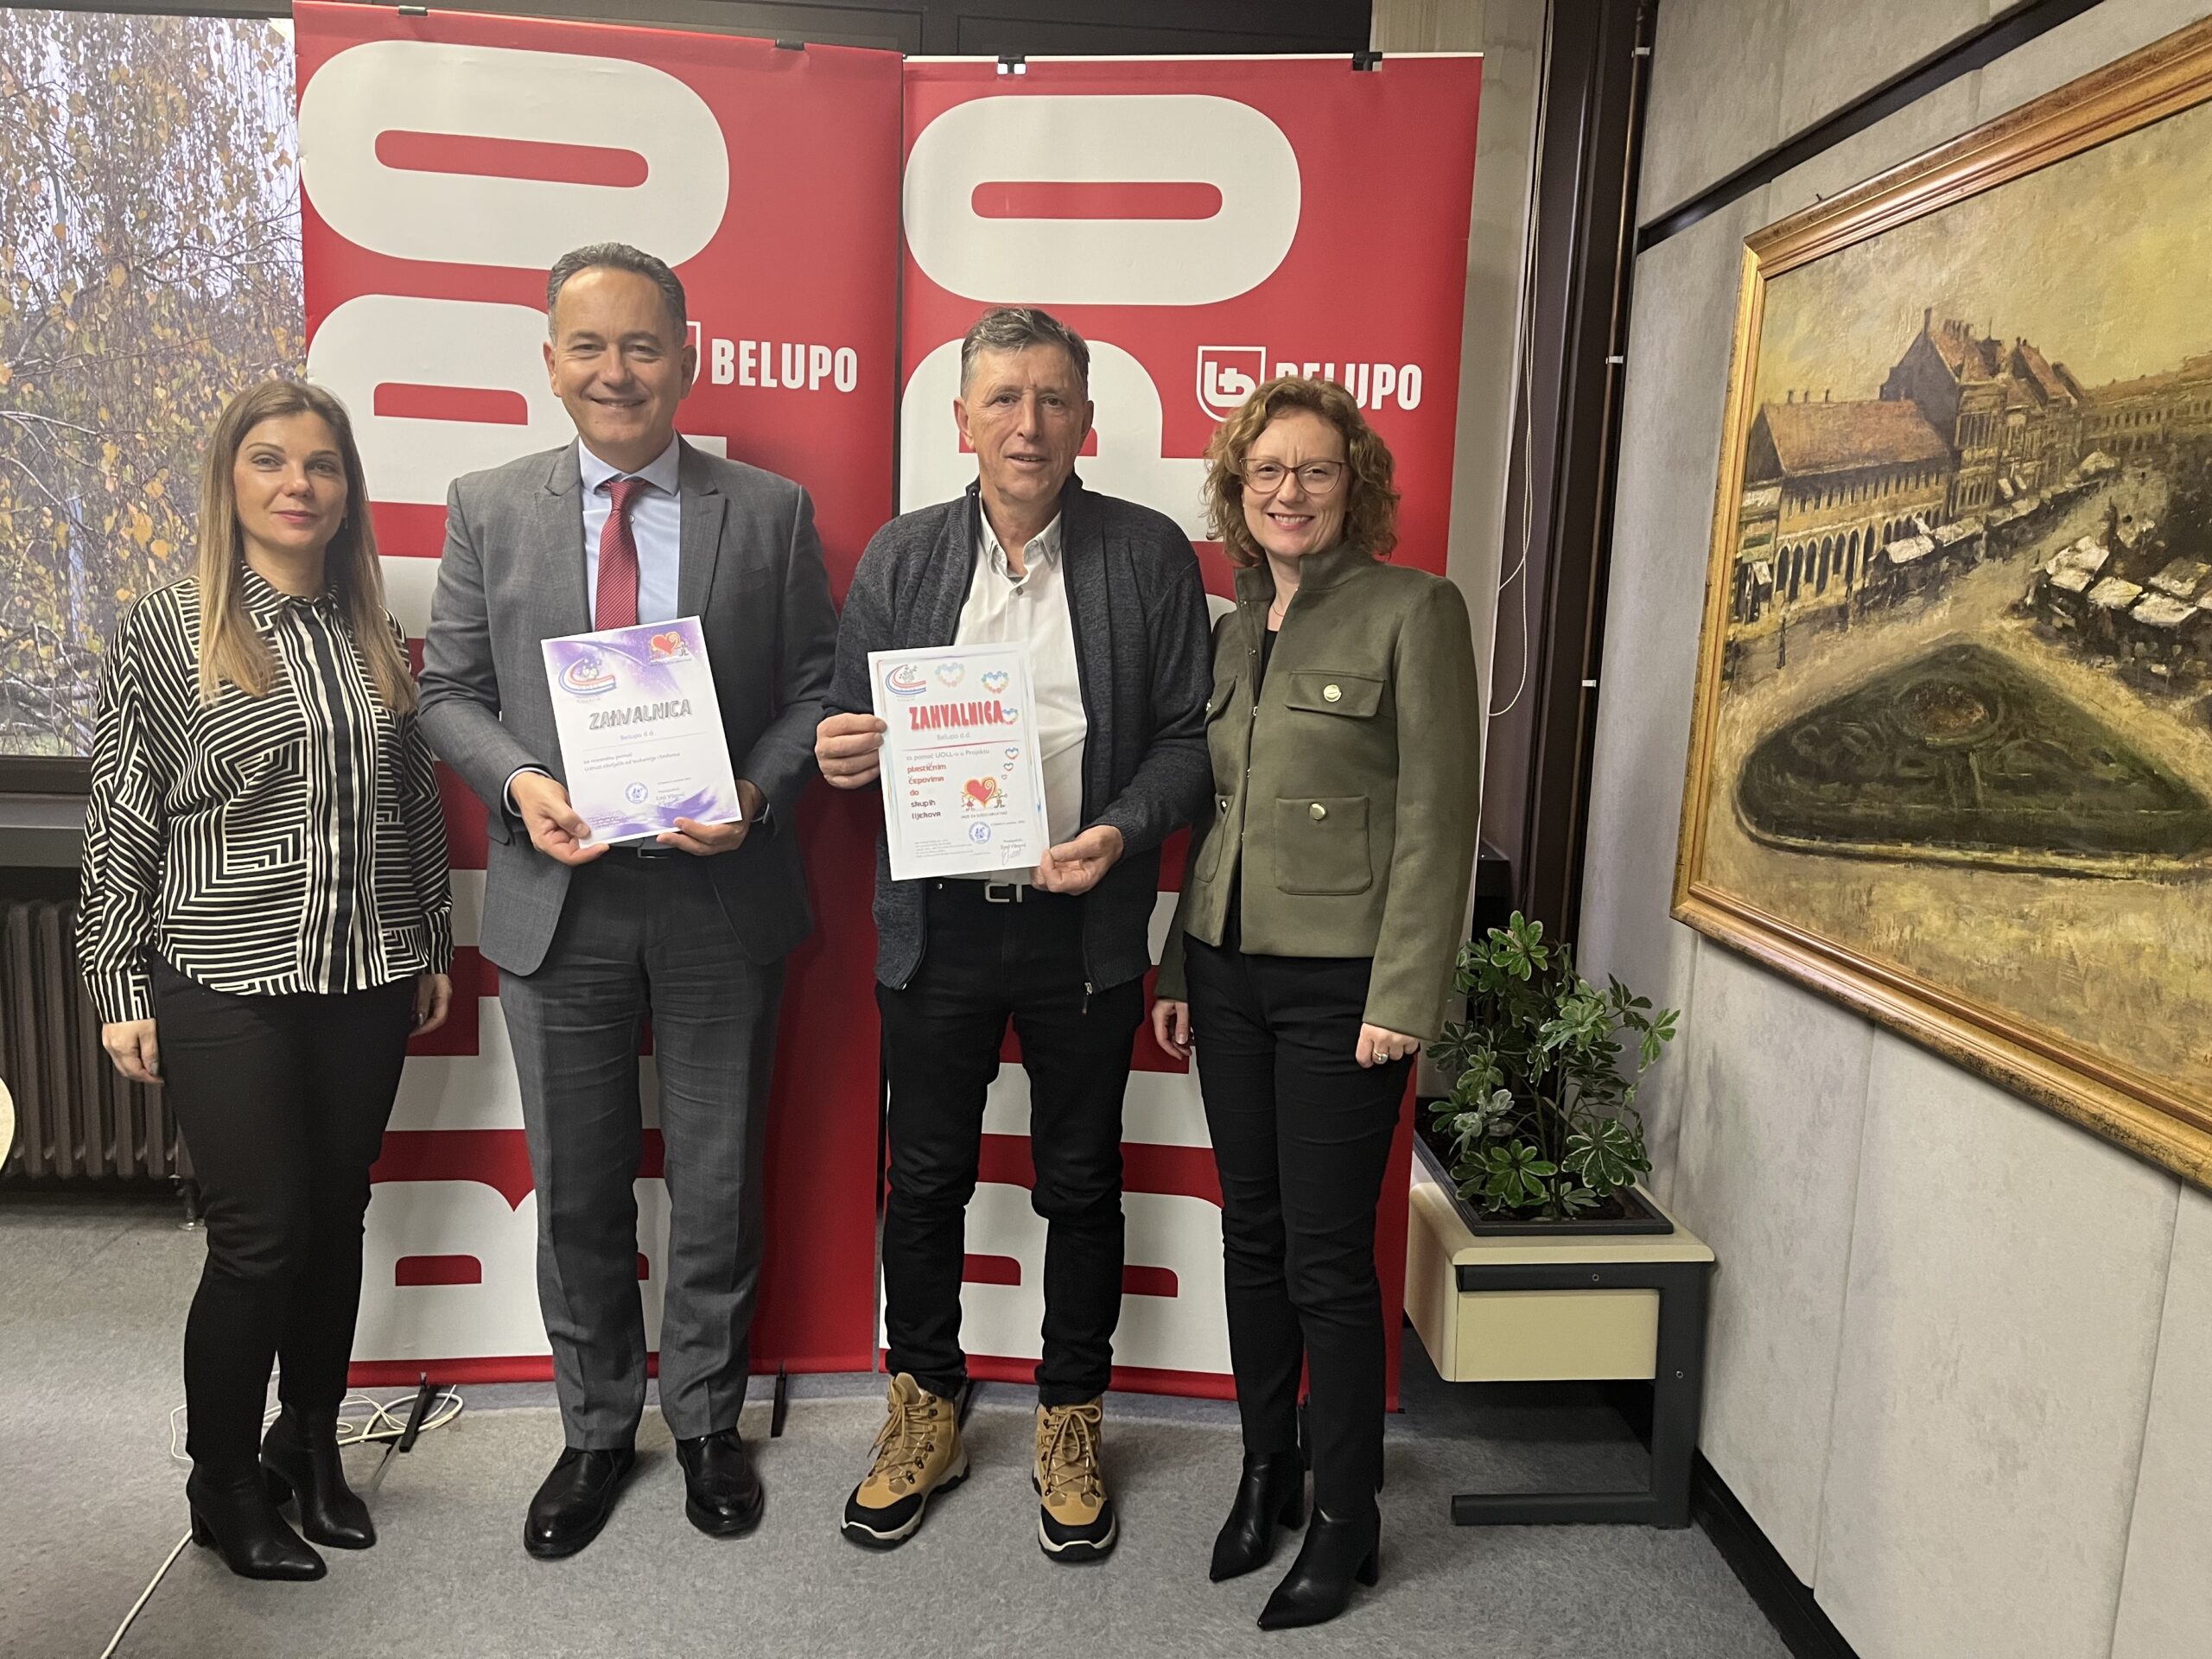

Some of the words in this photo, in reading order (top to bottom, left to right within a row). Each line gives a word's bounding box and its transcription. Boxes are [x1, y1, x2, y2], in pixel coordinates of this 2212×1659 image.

[712, 338, 858, 392] BELUPO
[589, 698, 692, 730] ZAHVALNICA
[909, 700, 1003, 730] ZAHVALNICA
[911, 799, 936, 808] skupih
[912, 811, 941, 820] lijekova
